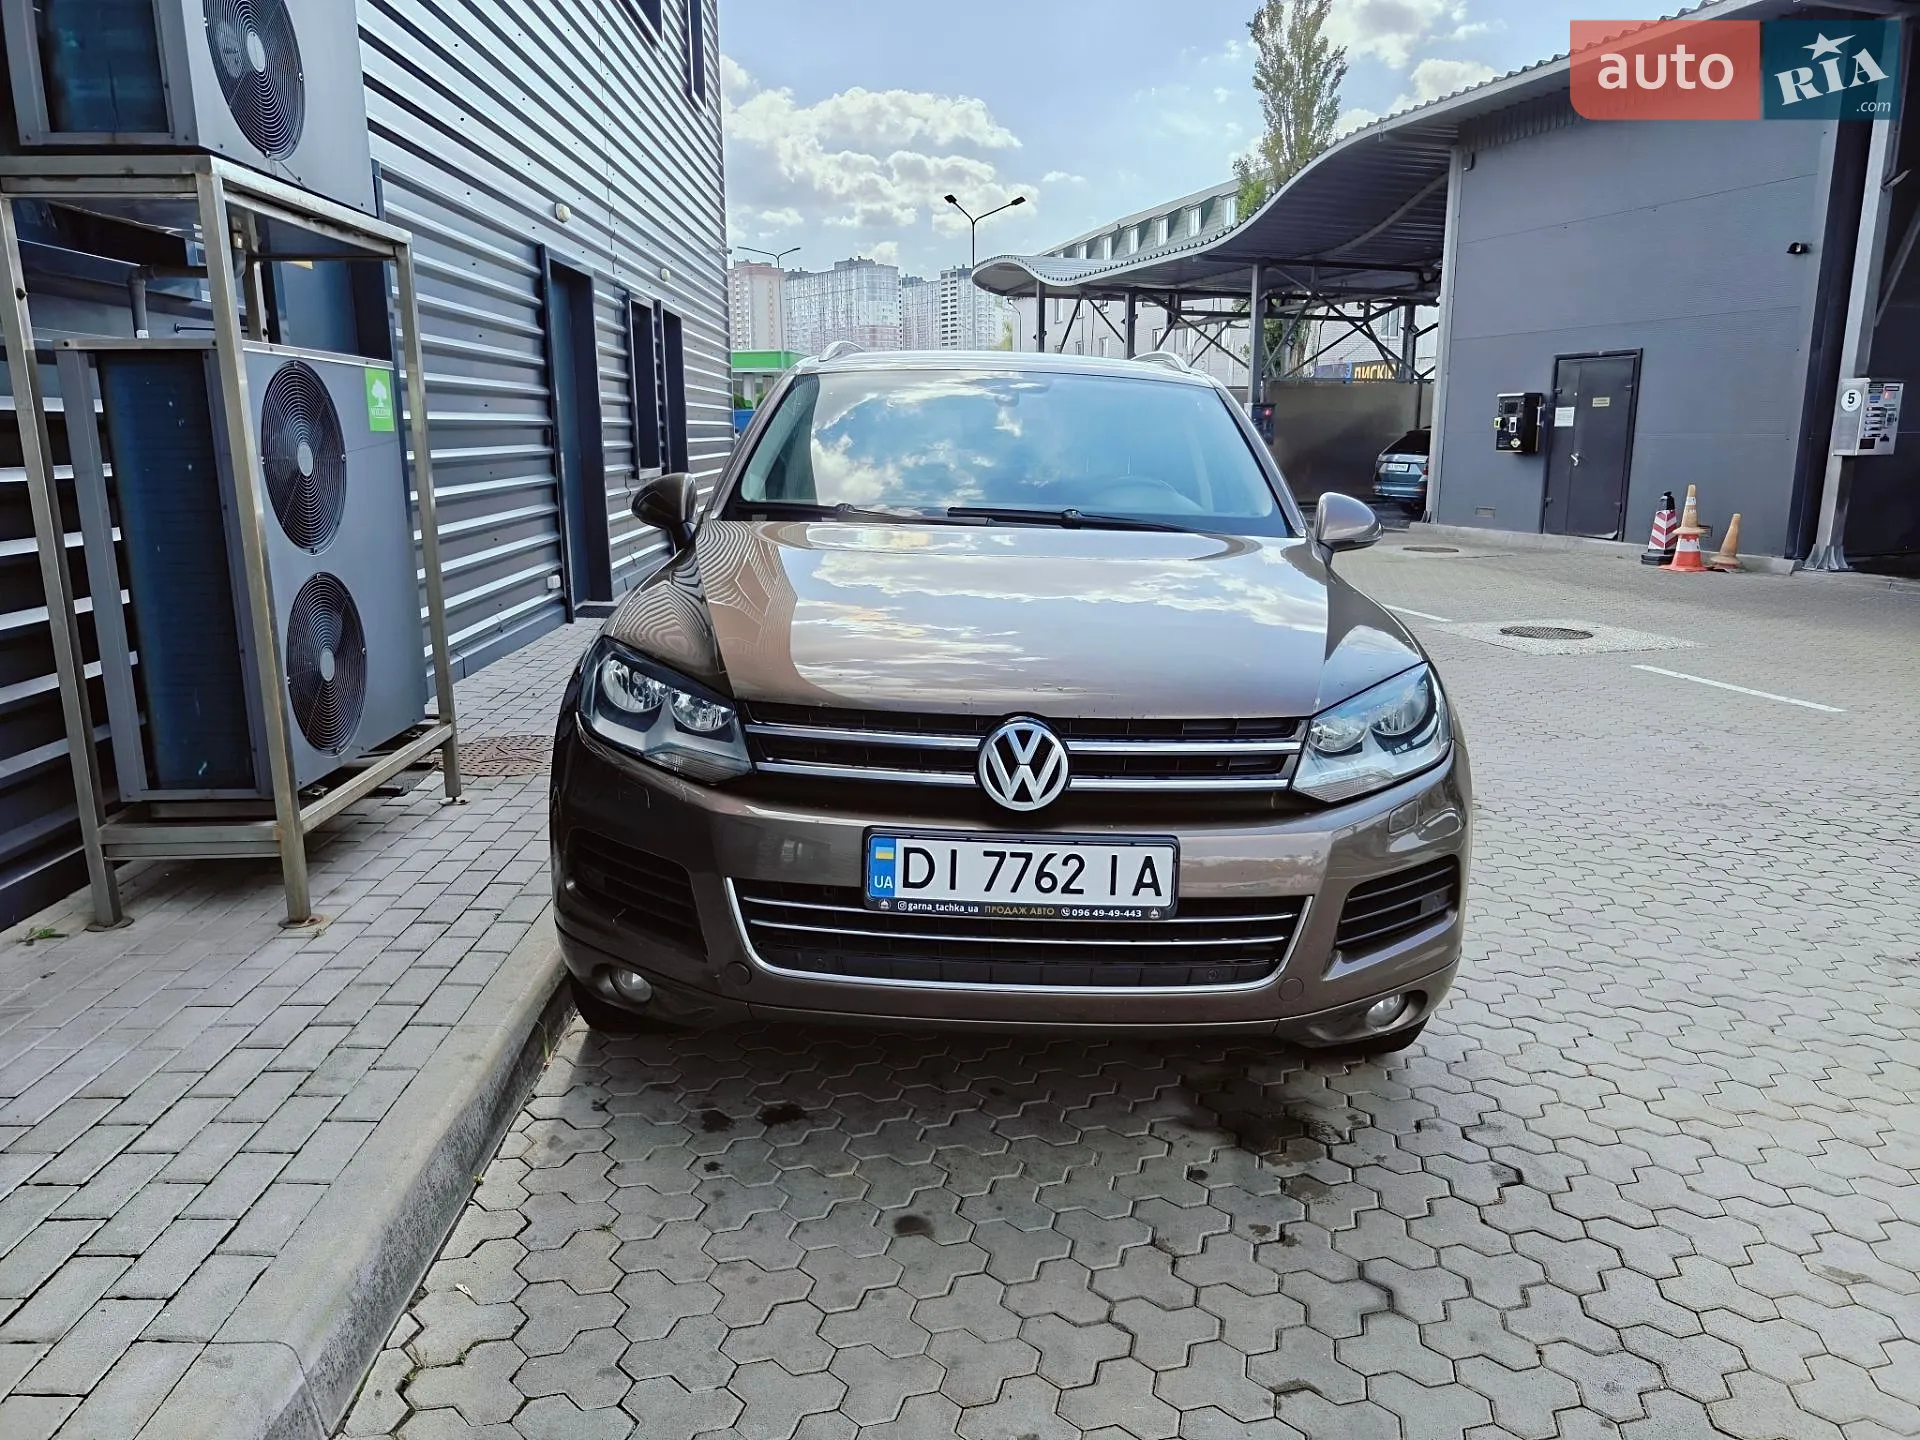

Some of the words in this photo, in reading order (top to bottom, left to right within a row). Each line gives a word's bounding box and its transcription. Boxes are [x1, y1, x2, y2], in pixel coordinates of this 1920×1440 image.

[1847, 392, 1856, 405] 5
[902, 846, 958, 891] DI
[983, 850, 1086, 896] 7762
[1109, 854, 1163, 897] IA
[874, 874, 894, 889] UA
[907, 902, 979, 914] garna_tachka_ua
[984, 905, 1028, 915] ПРОДАЖ
[1029, 907, 1055, 916] АВТО
[1071, 908, 1090, 917] 096
[1092, 909, 1142, 918] 49-49-443
